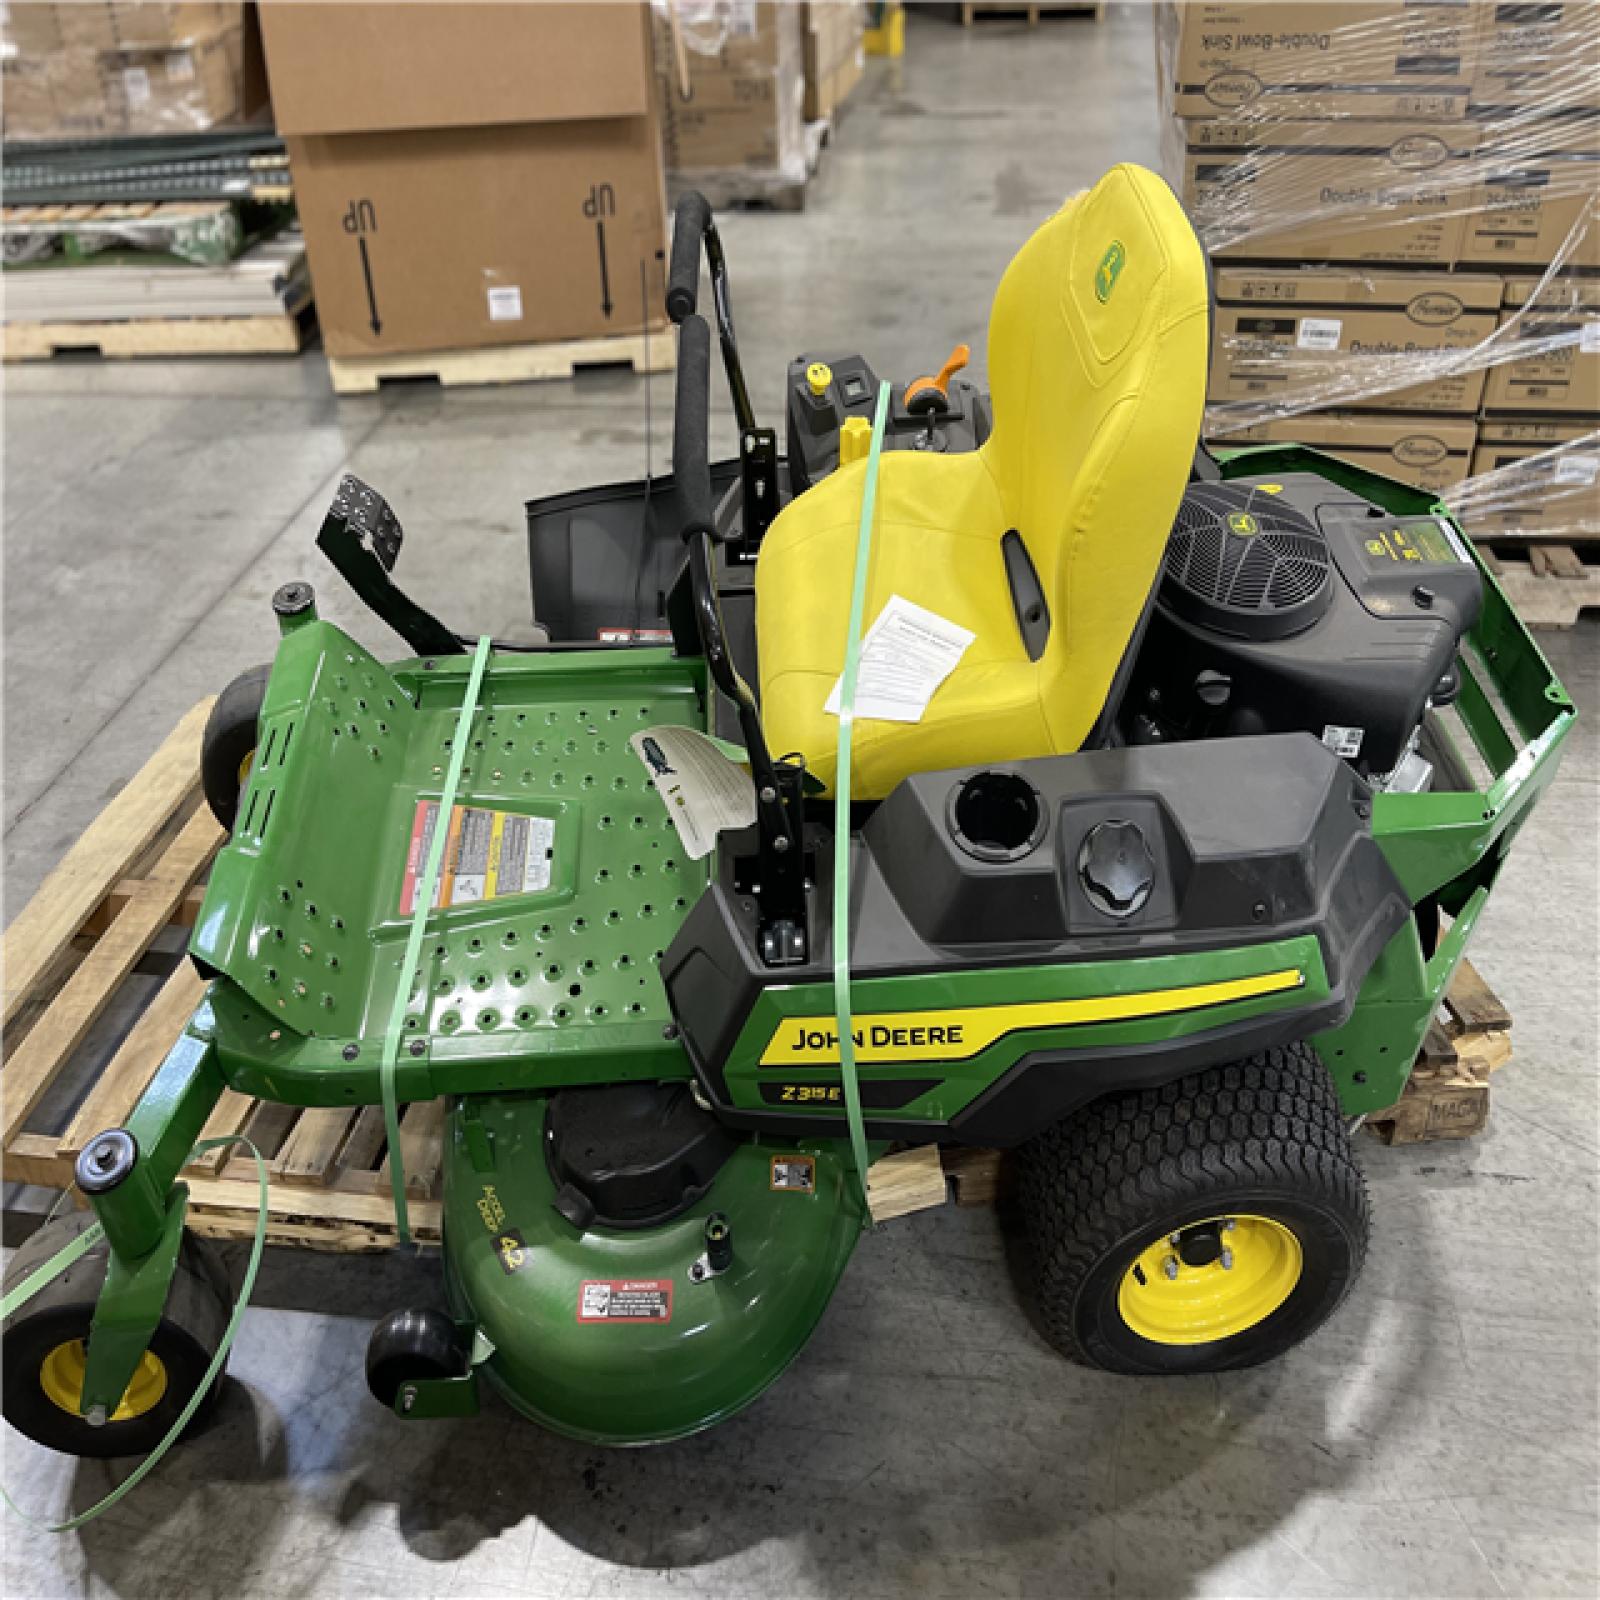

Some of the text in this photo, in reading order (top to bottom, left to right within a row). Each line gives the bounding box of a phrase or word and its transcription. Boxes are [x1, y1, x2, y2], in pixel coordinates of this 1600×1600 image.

[342, 197, 378, 233] UP
[583, 182, 616, 218] UP
[792, 1025, 964, 1051] JOHN DEERE
